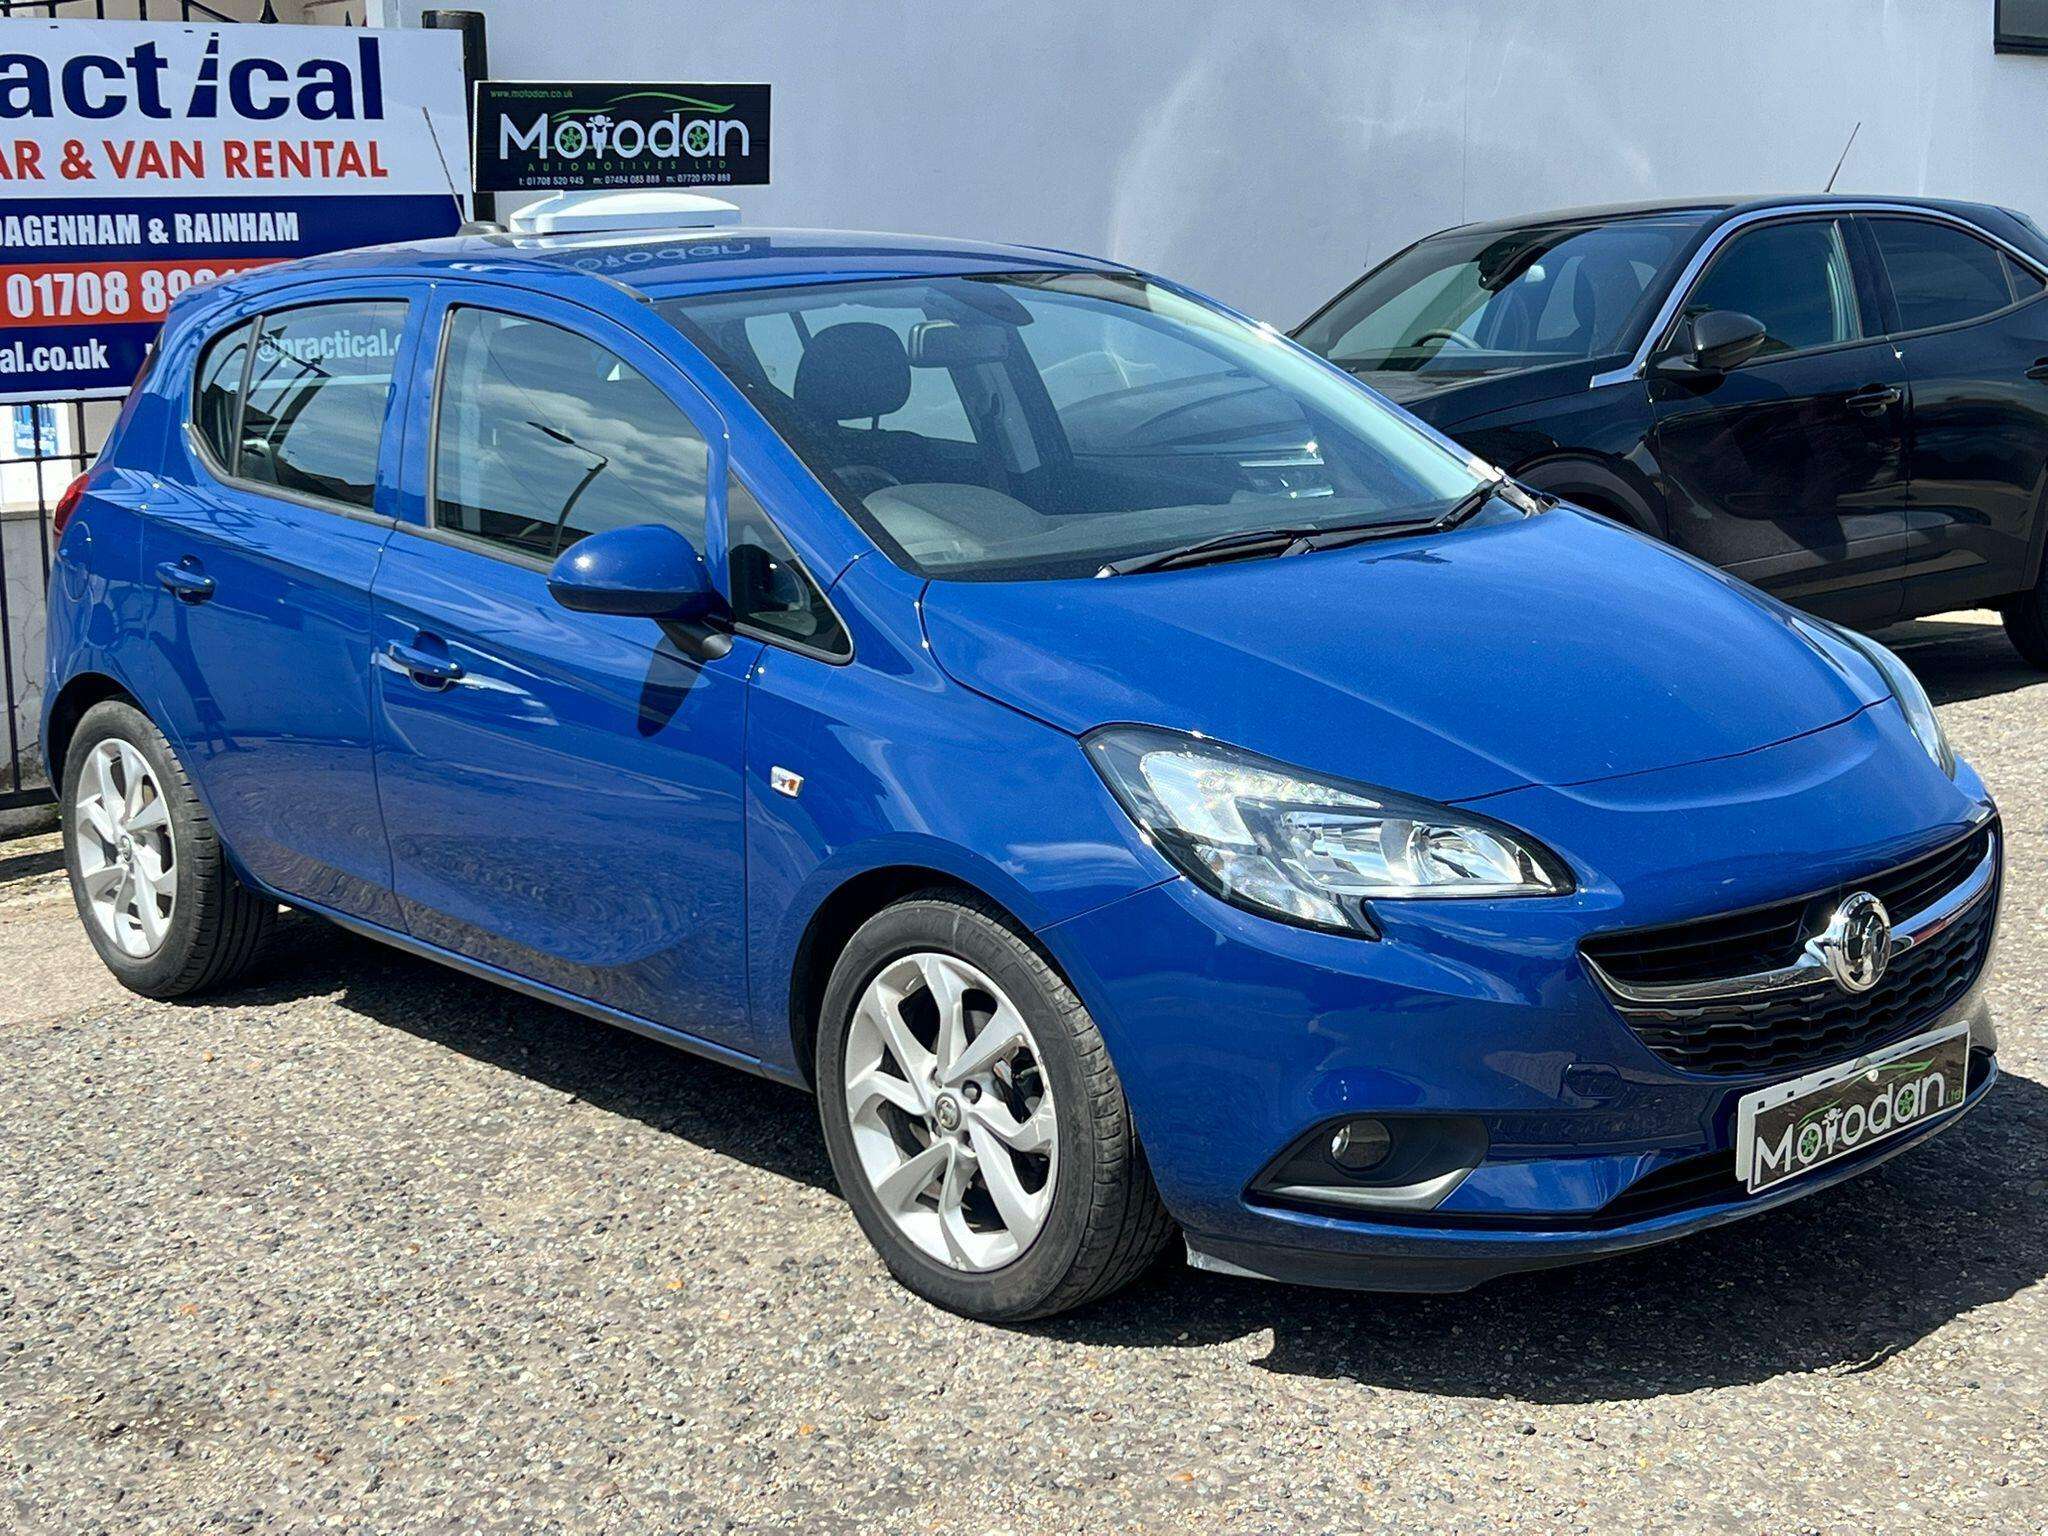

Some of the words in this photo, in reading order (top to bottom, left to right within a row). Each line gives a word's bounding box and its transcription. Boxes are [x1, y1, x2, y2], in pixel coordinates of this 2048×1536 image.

[499, 112, 750, 160] Motodan
[60, 139, 97, 181] &
[102, 140, 206, 180] VAN
[223, 140, 388, 179] RENTAL
[527, 160, 677, 172] AUTOMOTIVES
[694, 160, 727, 170] LTD
[0, 214, 141, 247] AGENHAM
[148, 217, 169, 244] &
[174, 212, 299, 243] RAINHAM
[6, 271, 130, 318] 01708
[1754, 1071, 1945, 1186] Motodan
